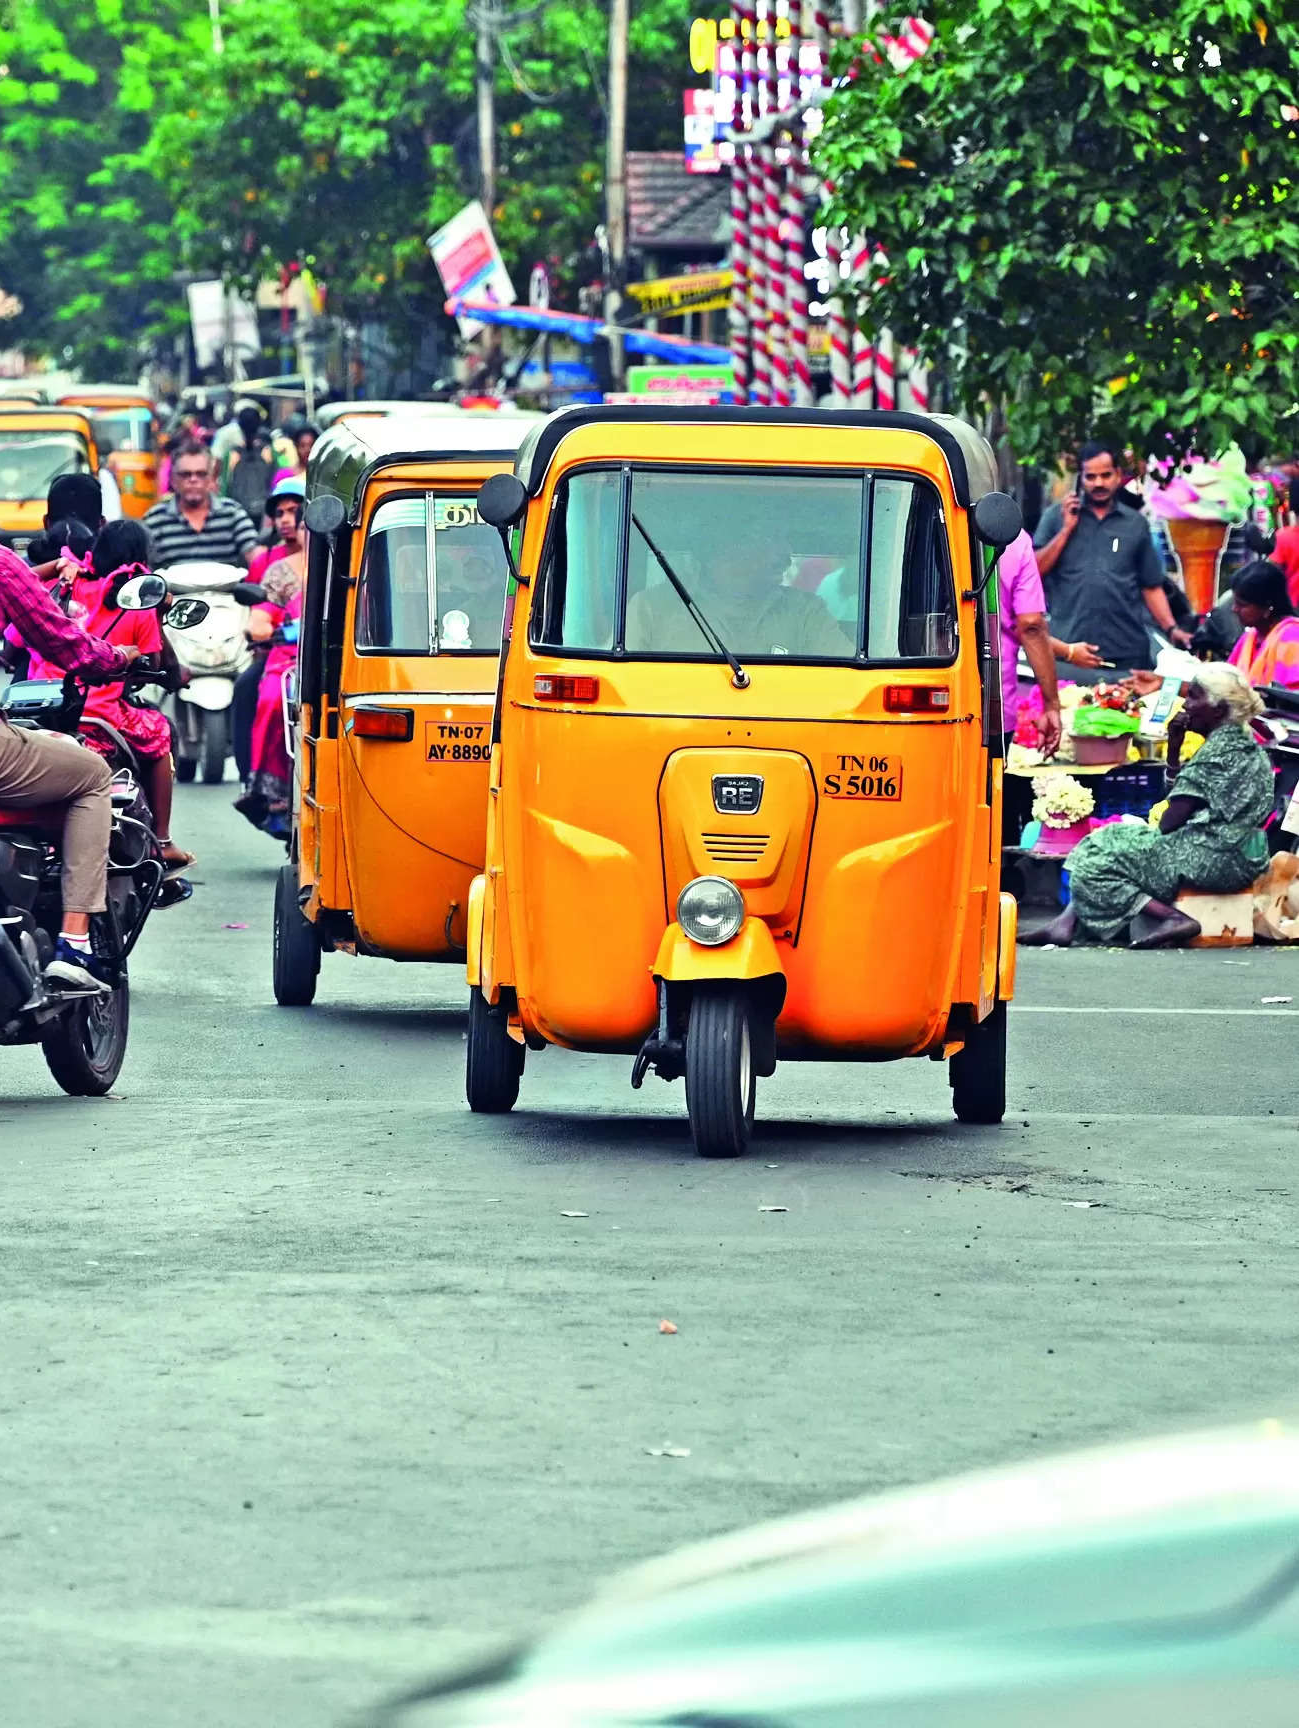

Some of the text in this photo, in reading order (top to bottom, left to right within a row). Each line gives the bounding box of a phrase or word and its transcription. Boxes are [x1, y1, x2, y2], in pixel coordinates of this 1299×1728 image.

[837, 755, 889, 773] TN 06
[824, 775, 897, 797] S 5016
[721, 787, 753, 805] RE
